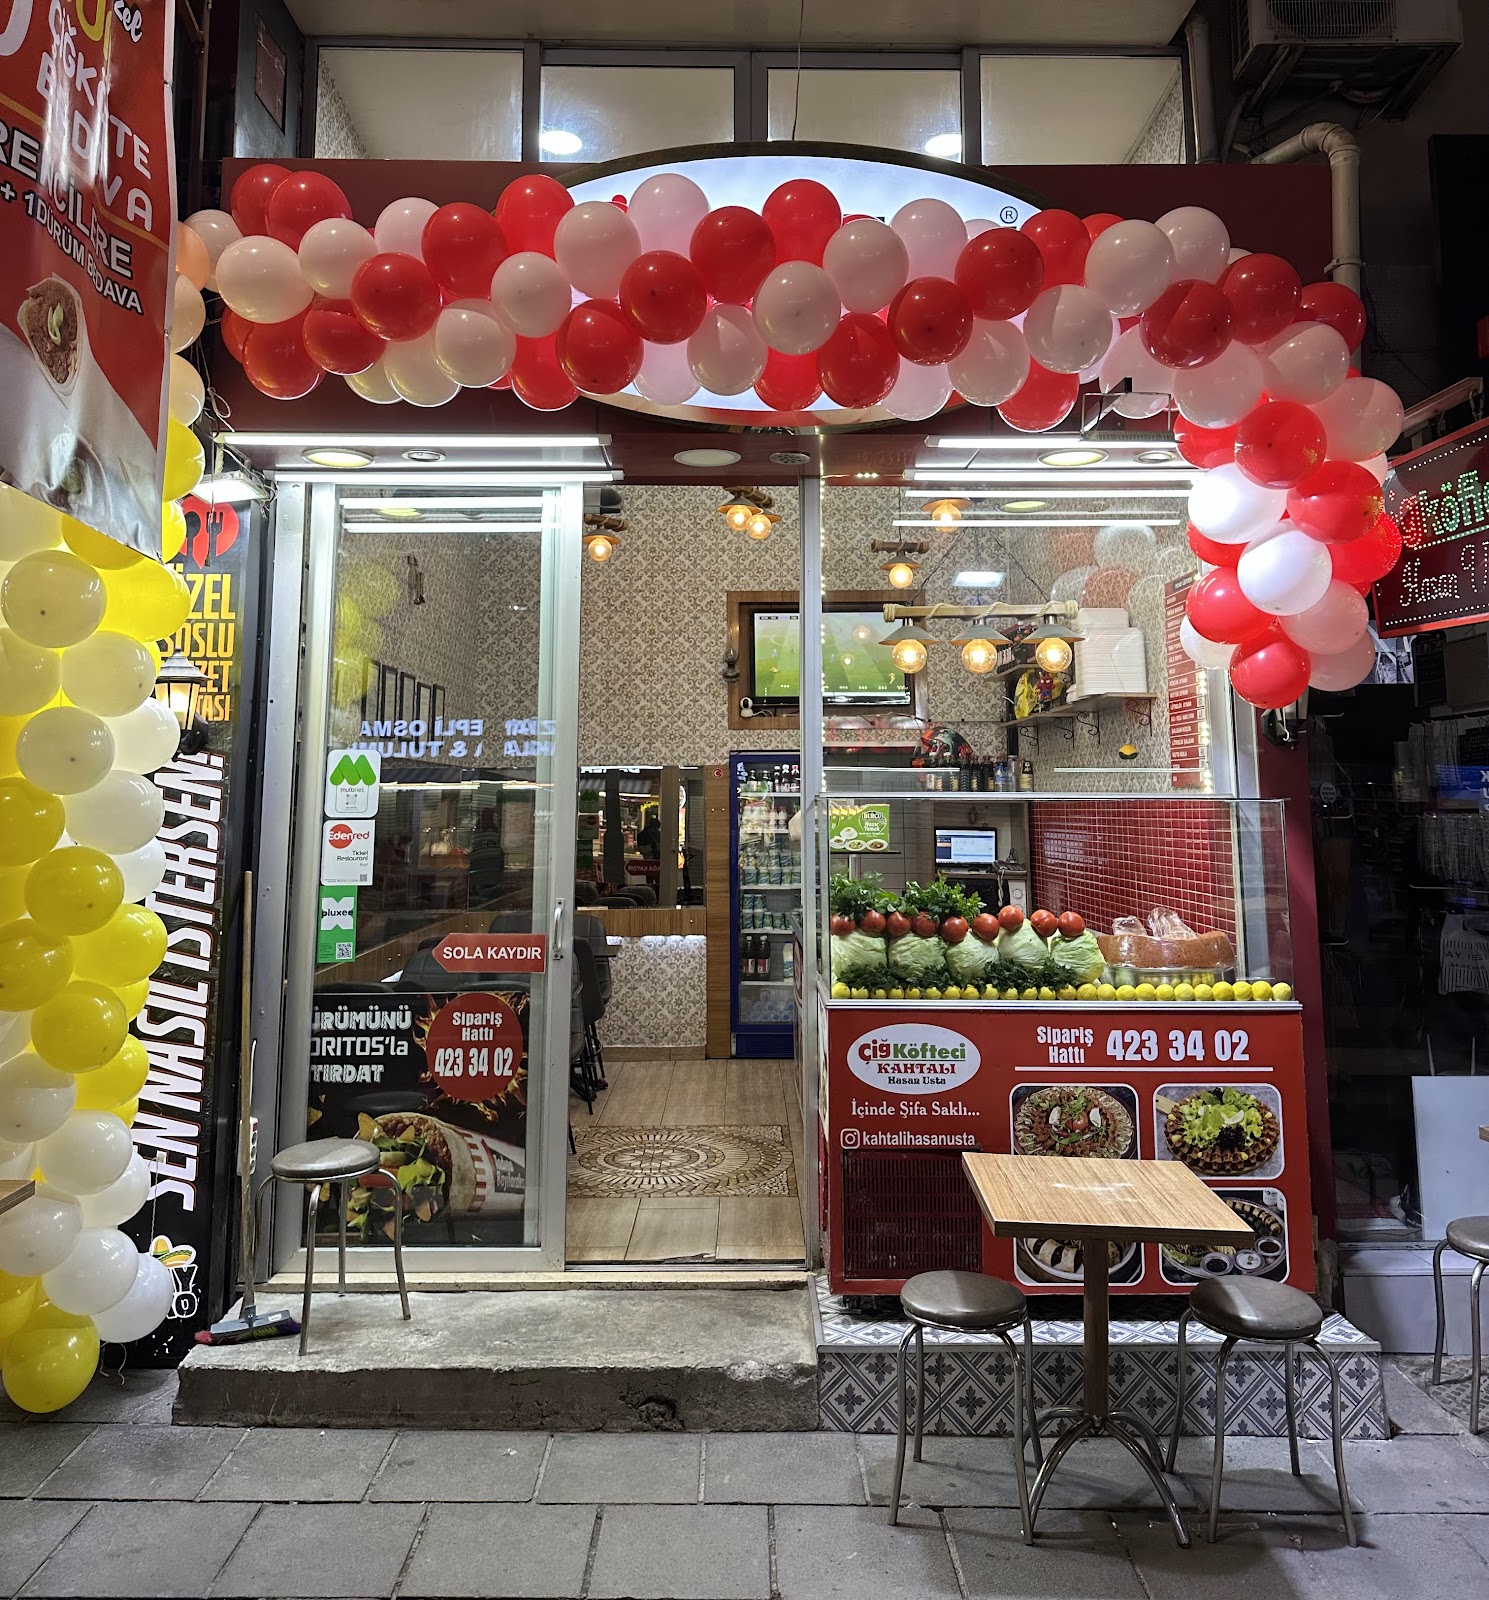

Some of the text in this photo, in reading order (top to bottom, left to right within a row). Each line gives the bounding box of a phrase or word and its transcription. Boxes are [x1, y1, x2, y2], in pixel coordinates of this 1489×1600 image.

[49, 0, 151, 179] ÇİĞKTE
[37, 52, 152, 232] BDVA
[86, 252, 143, 316] BEDAVA
[328, 831, 370, 840] Edenred
[321, 908, 354, 918] pluxee
[442, 947, 542, 960] SOLA KAYDIR
[311, 1004, 413, 1030] ÜRÜMÜNÜ
[452, 1011, 503, 1028] Sipariş
[461, 1027, 494, 1041] Hattı
[1036, 1025, 1094, 1047] Sipariş
[134, 977, 208, 1112] NASIL
[310, 1036, 409, 1057] ORITOS'la
[1106, 1029, 1250, 1062] 423 34 02
[434, 1047, 513, 1077] 423 34 02
[1048, 1046, 1085, 1064] Hattı
[310, 1064, 385, 1084] TIRDAT
[877, 1063, 956, 1075] KAHTALI
[888, 1076, 946, 1085] Hasan Usta
[851, 1098, 896, 1118] İçinde
[899, 1101, 928, 1118] Şifa
[862, 1129, 976, 1148] kahtalihasanusta
